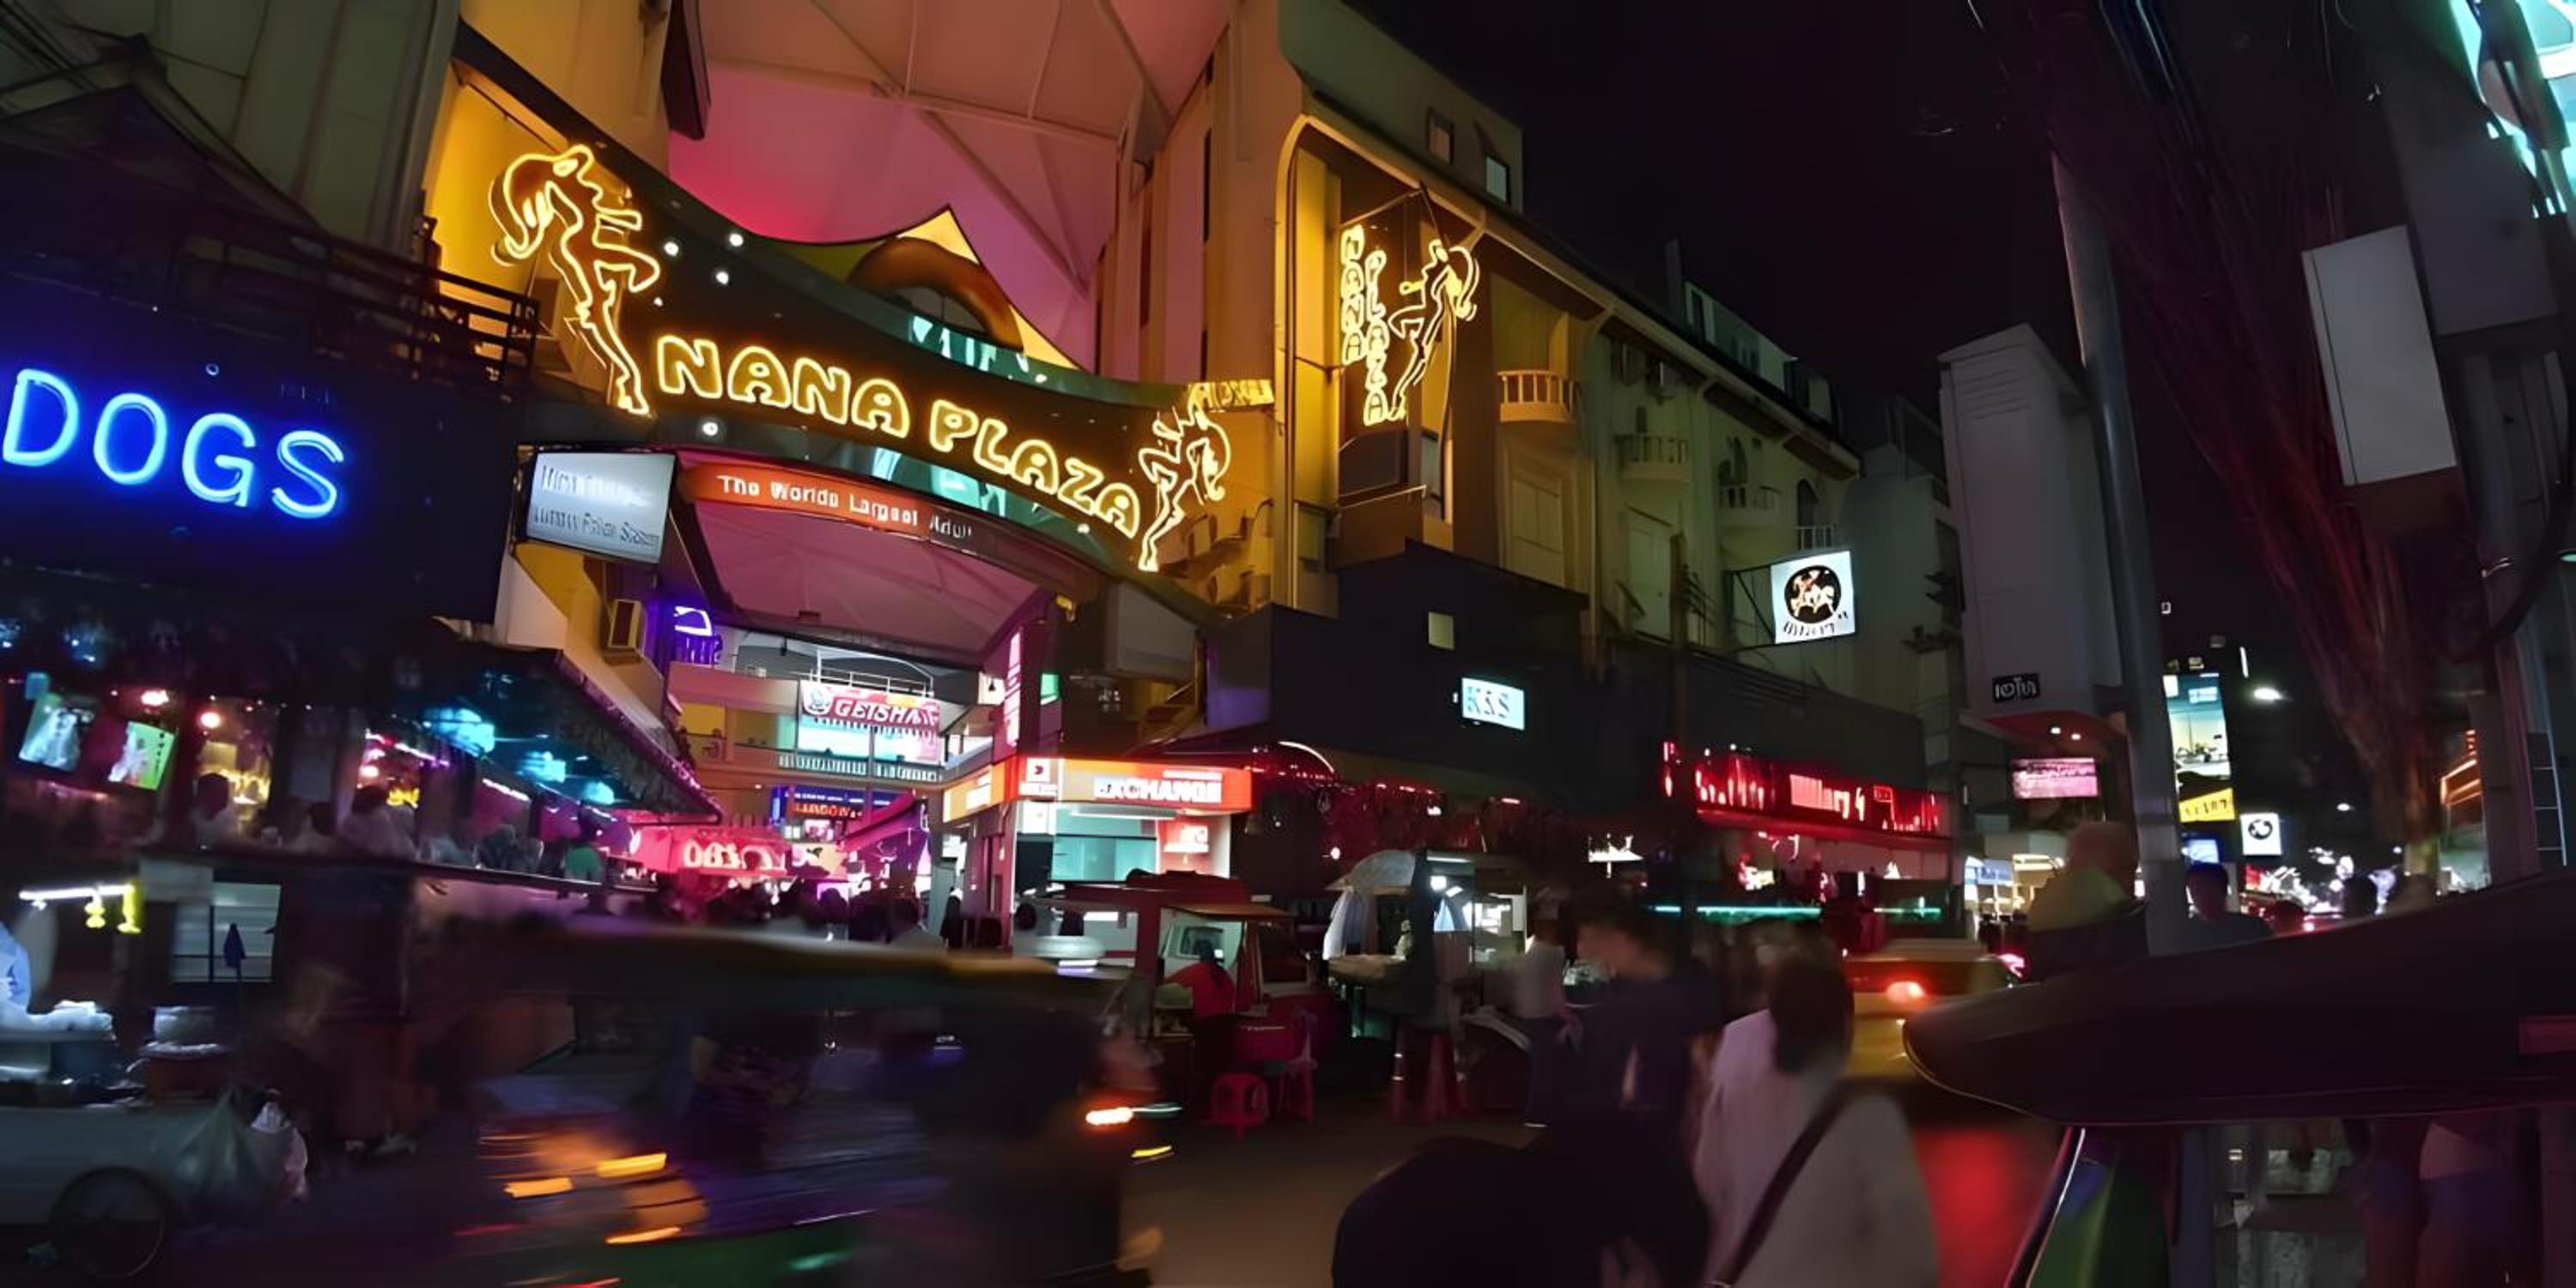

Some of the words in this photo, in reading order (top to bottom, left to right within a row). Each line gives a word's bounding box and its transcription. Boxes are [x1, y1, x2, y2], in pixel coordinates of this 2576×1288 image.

[1341, 224, 1367, 366] NANA
[1364, 250, 1389, 426] PLAZA
[3, 368, 343, 519] DOGS
[655, 335, 911, 439] NANA
[928, 398, 1141, 540] PLAZA
